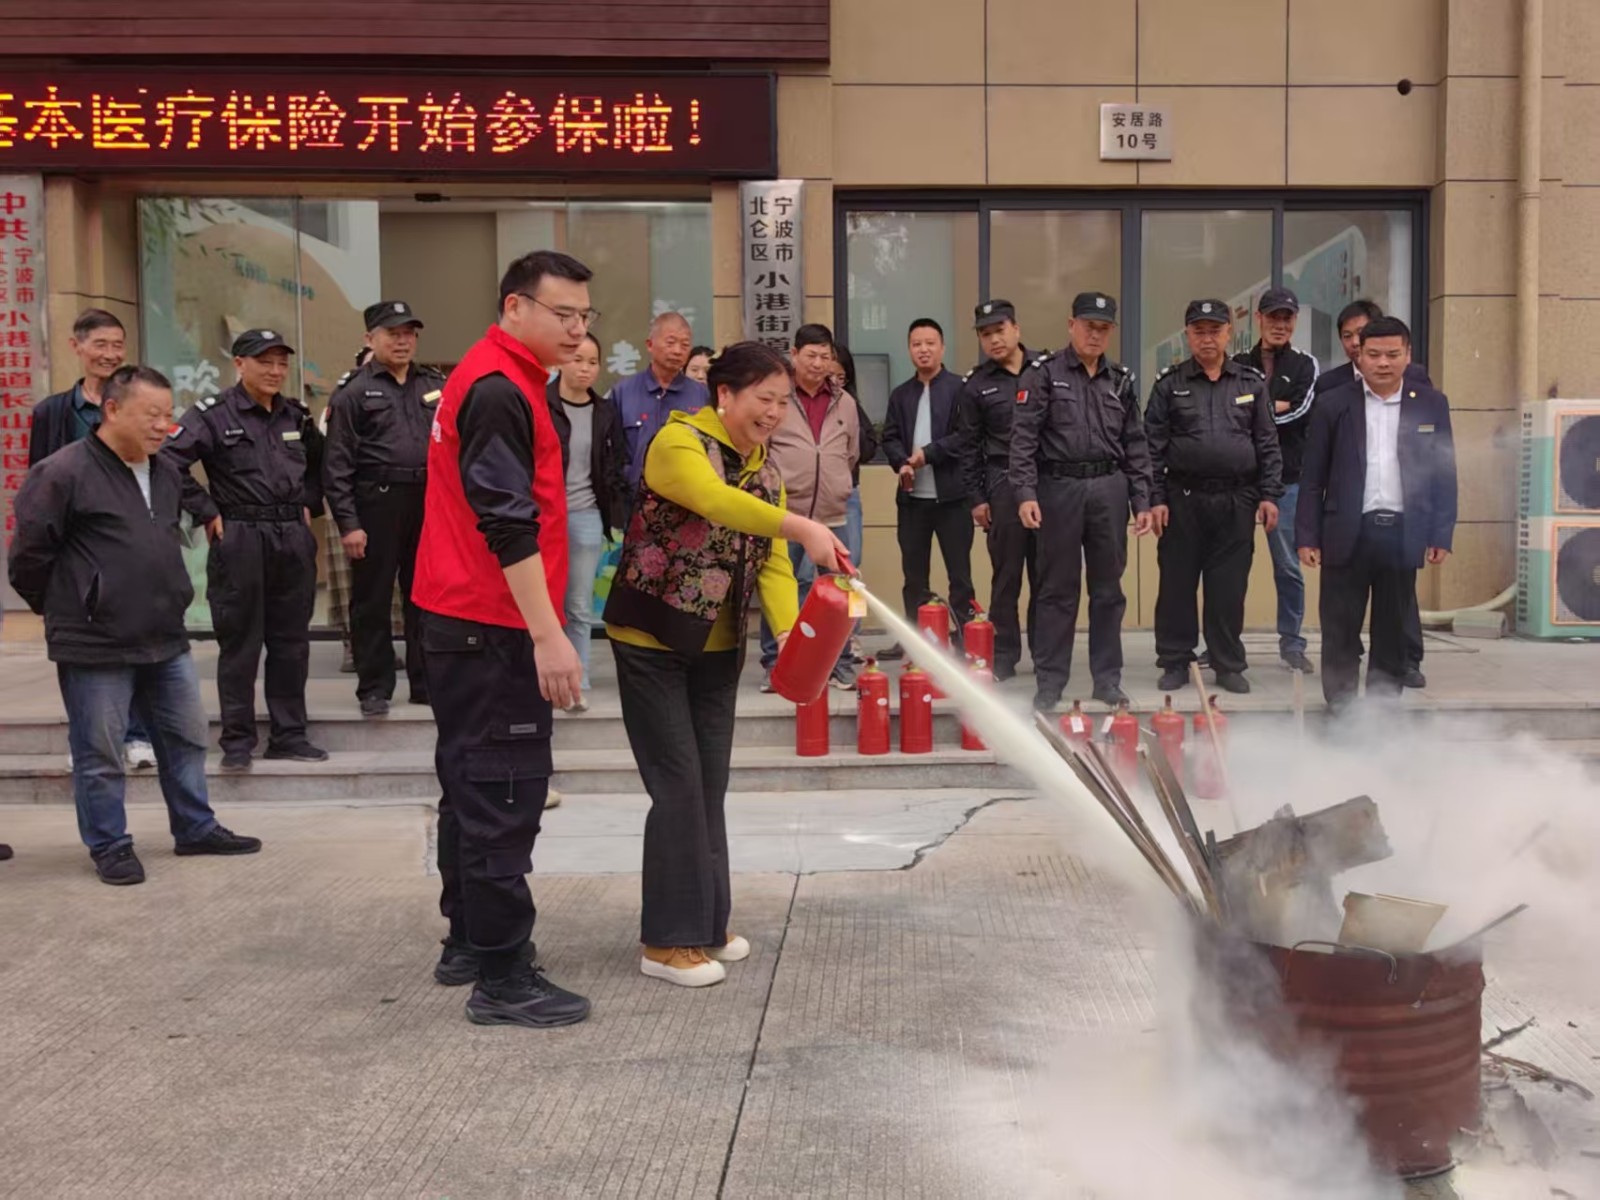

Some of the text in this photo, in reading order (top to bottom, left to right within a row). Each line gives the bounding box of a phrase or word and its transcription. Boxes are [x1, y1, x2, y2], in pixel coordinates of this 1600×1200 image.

[1112, 112, 1163, 128] 安居路
[1116, 133, 1157, 150] 10号
[0, 192, 29, 241] 中共
[749, 196, 769, 262] 北仑区
[774, 197, 794, 262] 宁波市
[15, 248, 34, 303] 宁波市
